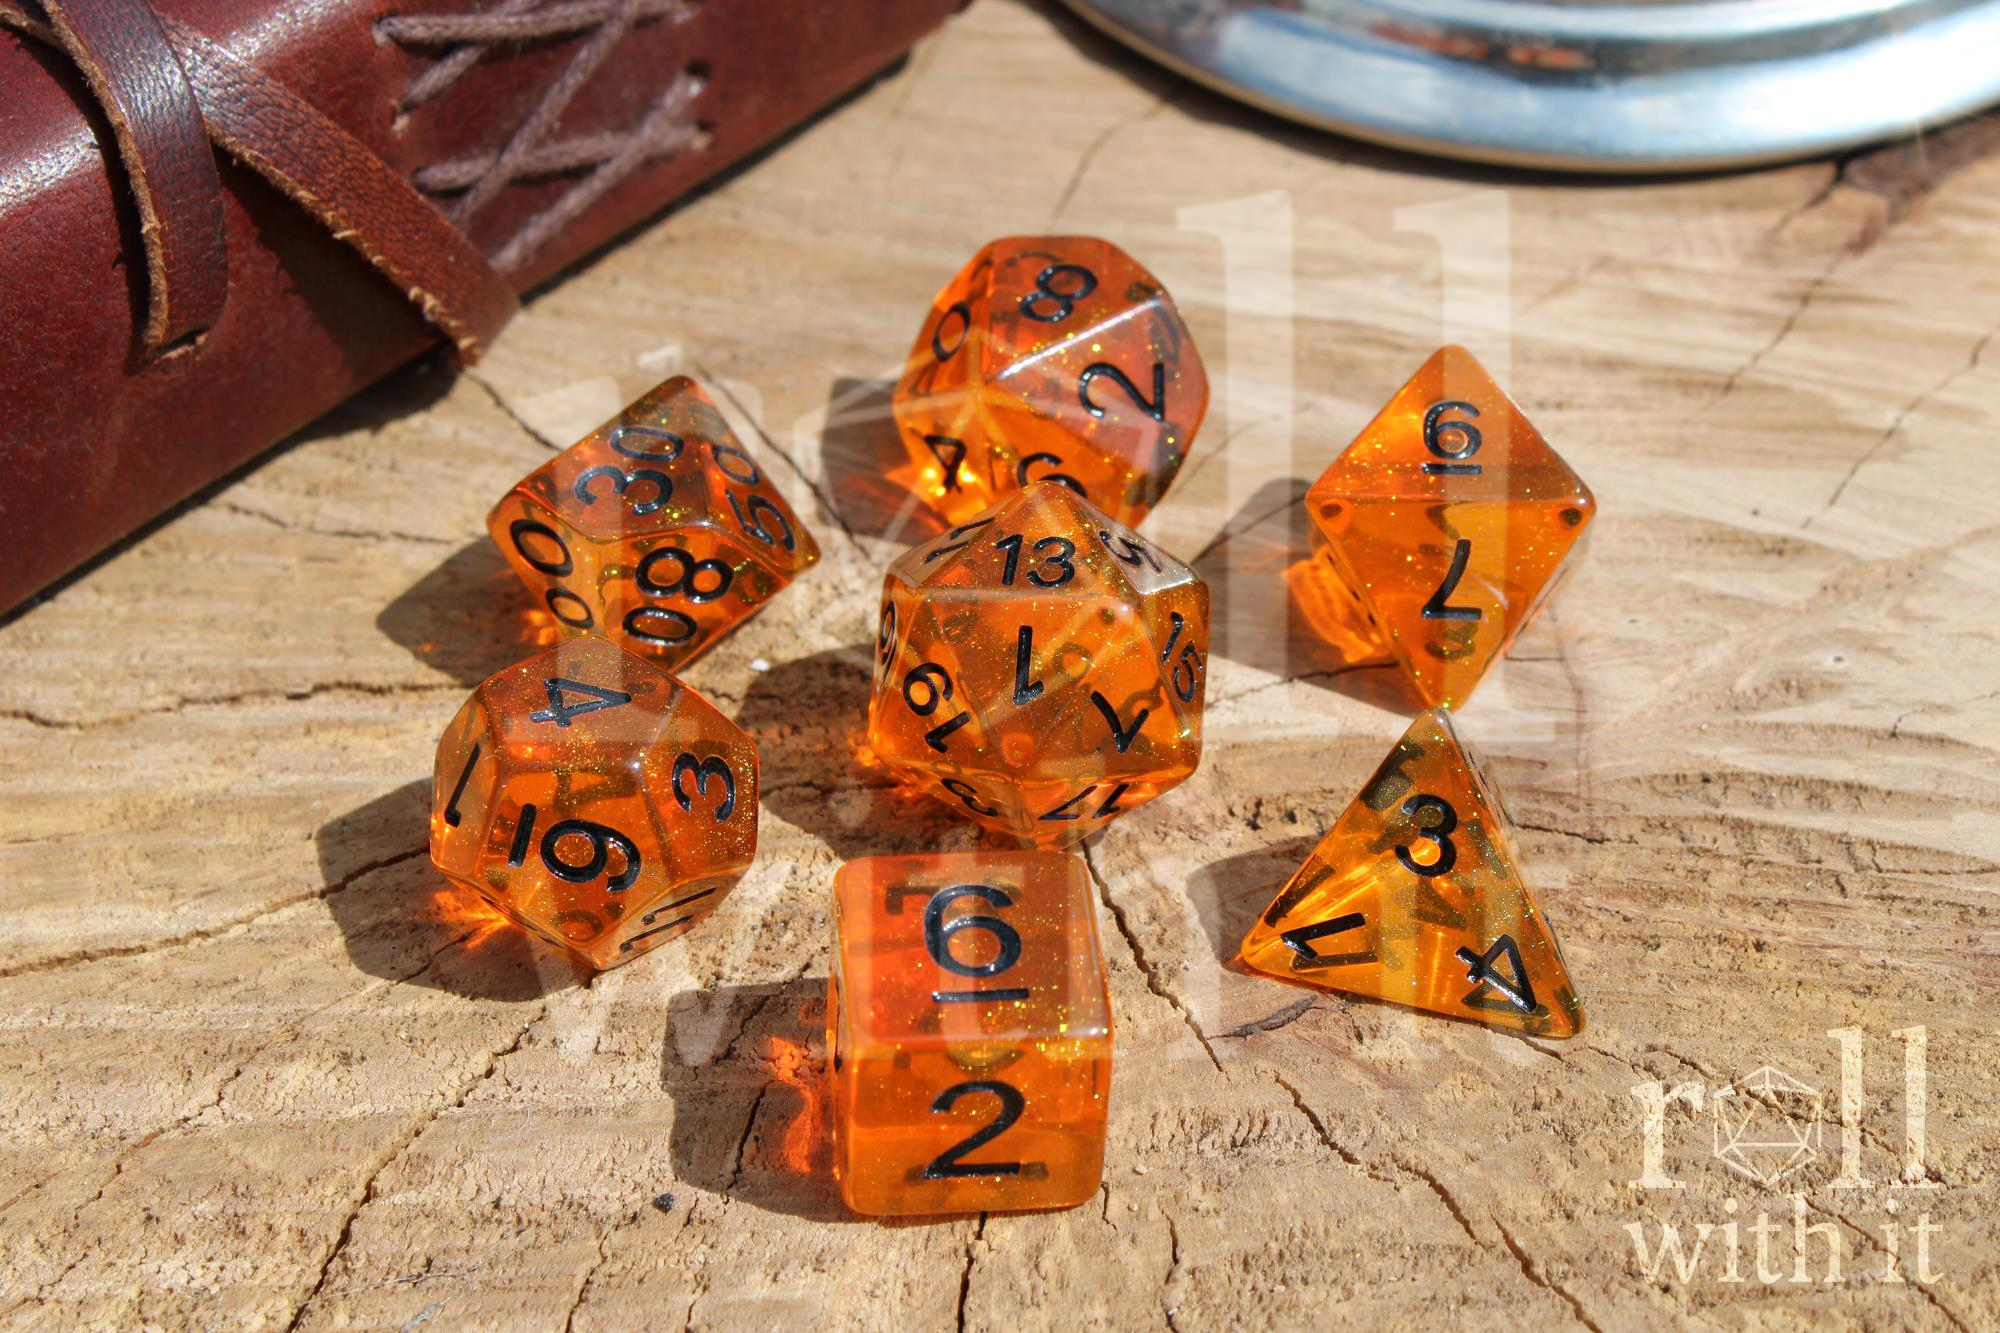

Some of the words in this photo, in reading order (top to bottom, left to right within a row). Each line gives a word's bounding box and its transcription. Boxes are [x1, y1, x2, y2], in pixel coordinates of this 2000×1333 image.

[932, 301, 971, 362] 0
[1019, 264, 1098, 323] 8
[1078, 362, 1166, 422] 2
[574, 426, 684, 517] 30
[711, 445, 796, 551] 50
[923, 434, 967, 494] 4
[509, 519, 595, 630] 00
[622, 546, 733, 646] 80
[996, 533, 1076, 589] 13
[1421, 538, 1482, 620] 7
[1013, 625, 1044, 706] 1
[1161, 611, 1203, 704] 15
[529, 677, 632, 728] 4
[903, 662, 971, 753] 19
[671, 751, 735, 824] 3
[1394, 793, 1458, 878] 3
[923, 884, 1031, 1002] 6
[1279, 912, 1367, 961] 1
[1454, 933, 1538, 1014] 4
[921, 1079, 1026, 1181] 2
